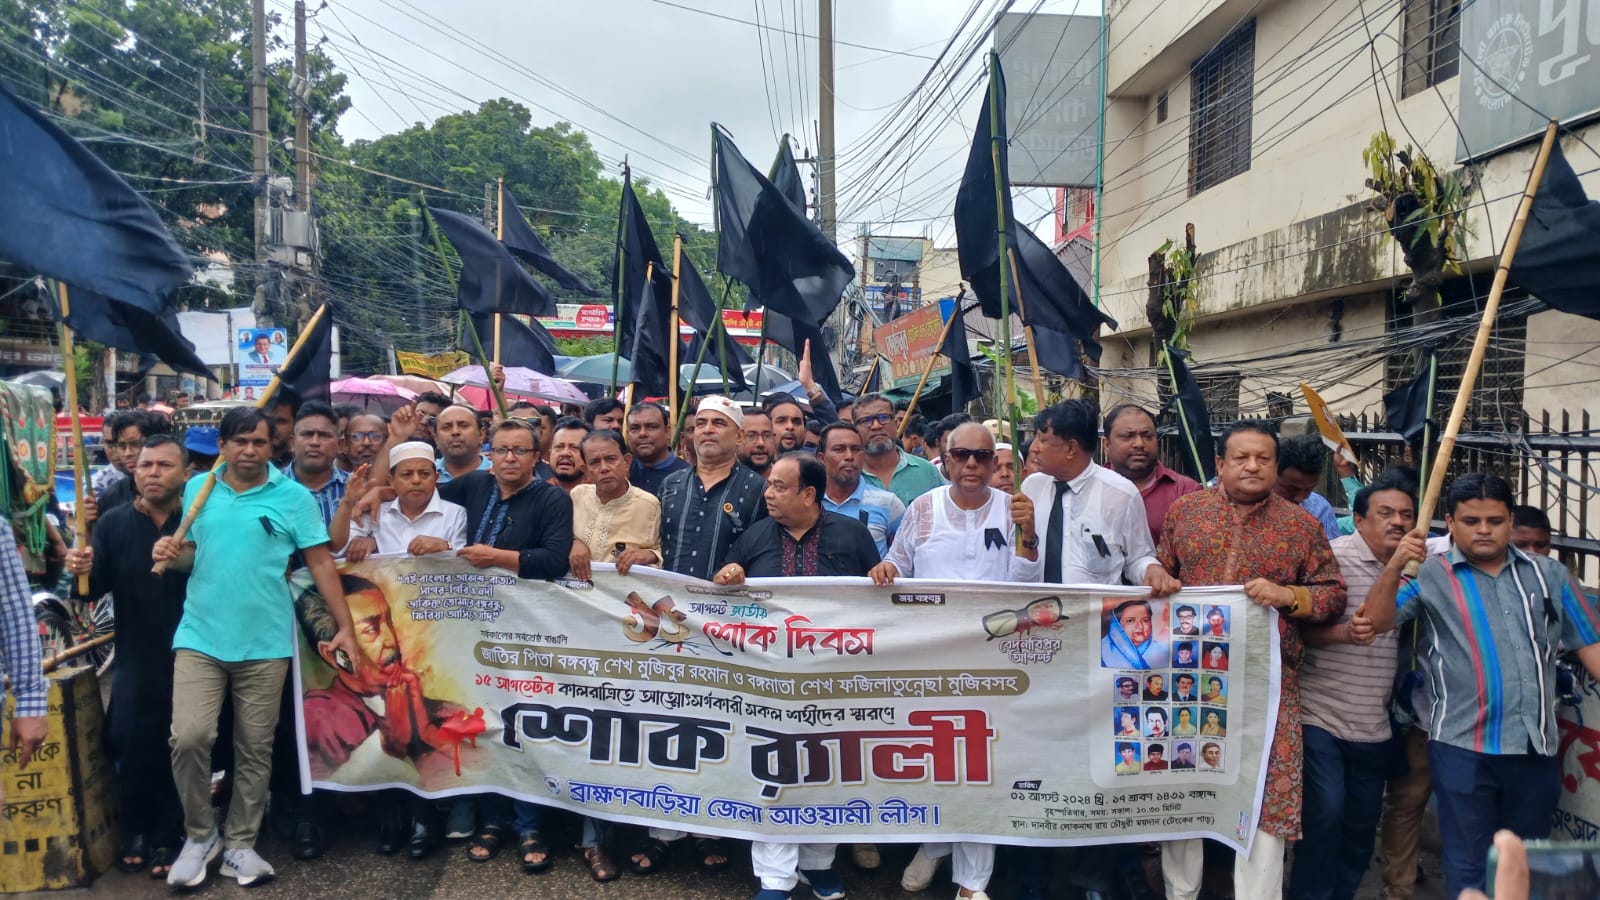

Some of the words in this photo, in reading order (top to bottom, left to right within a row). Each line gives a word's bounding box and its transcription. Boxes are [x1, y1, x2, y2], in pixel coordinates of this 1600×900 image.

[419, 574, 452, 584] বাংলার
[730, 602, 767, 619] জাতীয়
[702, 620, 778, 654] শোক
[784, 615, 876, 658] দিবস
[481, 647, 520, 666] জাতির
[522, 648, 554, 668] পিতা
[558, 653, 602, 677] বঙ্গবন্ধু
[604, 657, 633, 676] শেখ
[638, 659, 685, 683] মুজিবুর
[689, 663, 729, 686] রহমান
[733, 672, 744, 685] ও
[747, 673, 795, 696] বঙ্গমাতা
[800, 677, 834, 696] শেখ
[839, 674, 942, 697] ফজিলাতুন্নেছা
[947, 672, 1018, 696] মুজিবসহ
[475, 673, 492, 687] ১৫
[495, 675, 555, 698] আগস্টের
[558, 681, 635, 706] কালরাত্রিতে
[744, 702, 782, 722] সকল
[786, 704, 845, 727] শহীদের
[850, 705, 895, 725] স্মরণে
[501, 702, 731, 771] শোক
[15, 771, 43, 790] না
[1011, 792, 1026, 801] ০১
[1028, 791, 1060, 803] আগস্ট
[1063, 794, 1091, 805] ২০২৪
[1156, 791, 1185, 800] ১৪৩১
[568, 781, 702, 816] ব্রাহ্মণবাড়িয়া
[707, 797, 763, 824] জেলা
[769, 797, 872, 827] আওয়ামী
